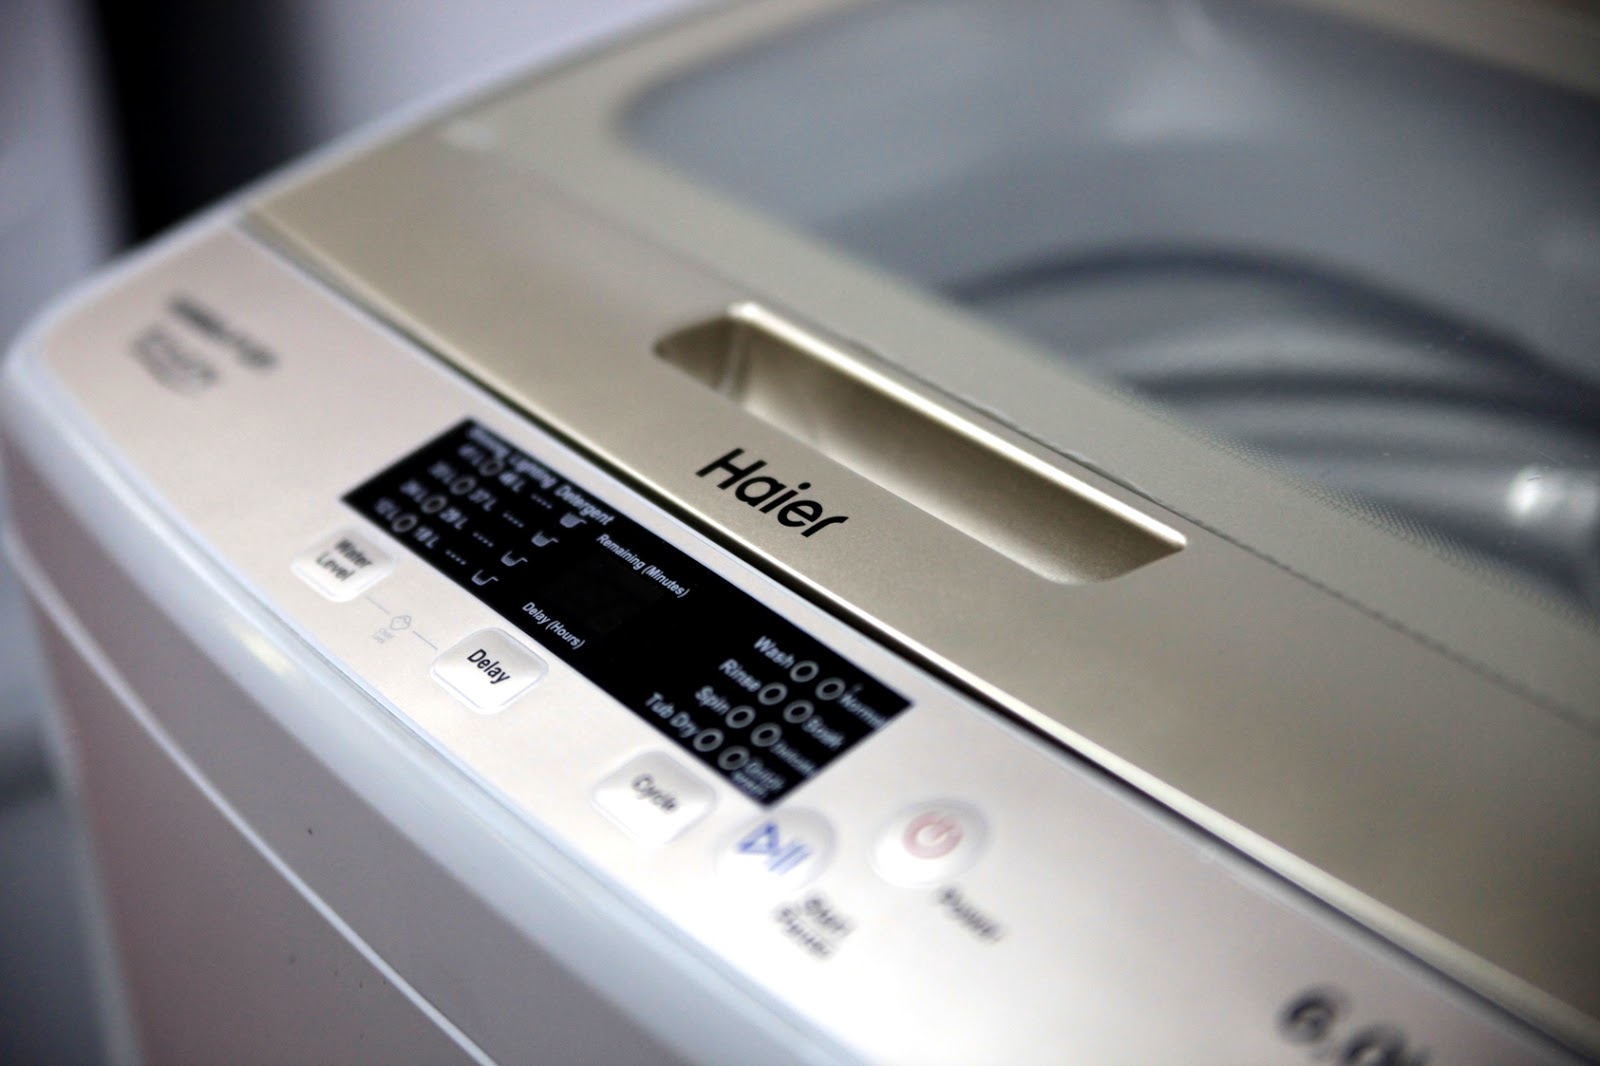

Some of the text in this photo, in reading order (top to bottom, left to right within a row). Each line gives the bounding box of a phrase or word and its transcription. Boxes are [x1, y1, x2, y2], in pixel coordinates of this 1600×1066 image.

[555, 485, 615, 526] Detergent
[695, 448, 849, 538] Haier
[316, 552, 357, 582] Level
[334, 537, 374, 570] Water
[596, 533, 691, 599] Remaining (Minutes)
[522, 601, 586, 650] Delay (Hours)
[467, 648, 512, 686] Delay
[754, 635, 795, 670] Wash
[718, 658, 761, 693] Rinse
[646, 692, 698, 739] Tub Dry
[695, 685, 731, 716] Spin
